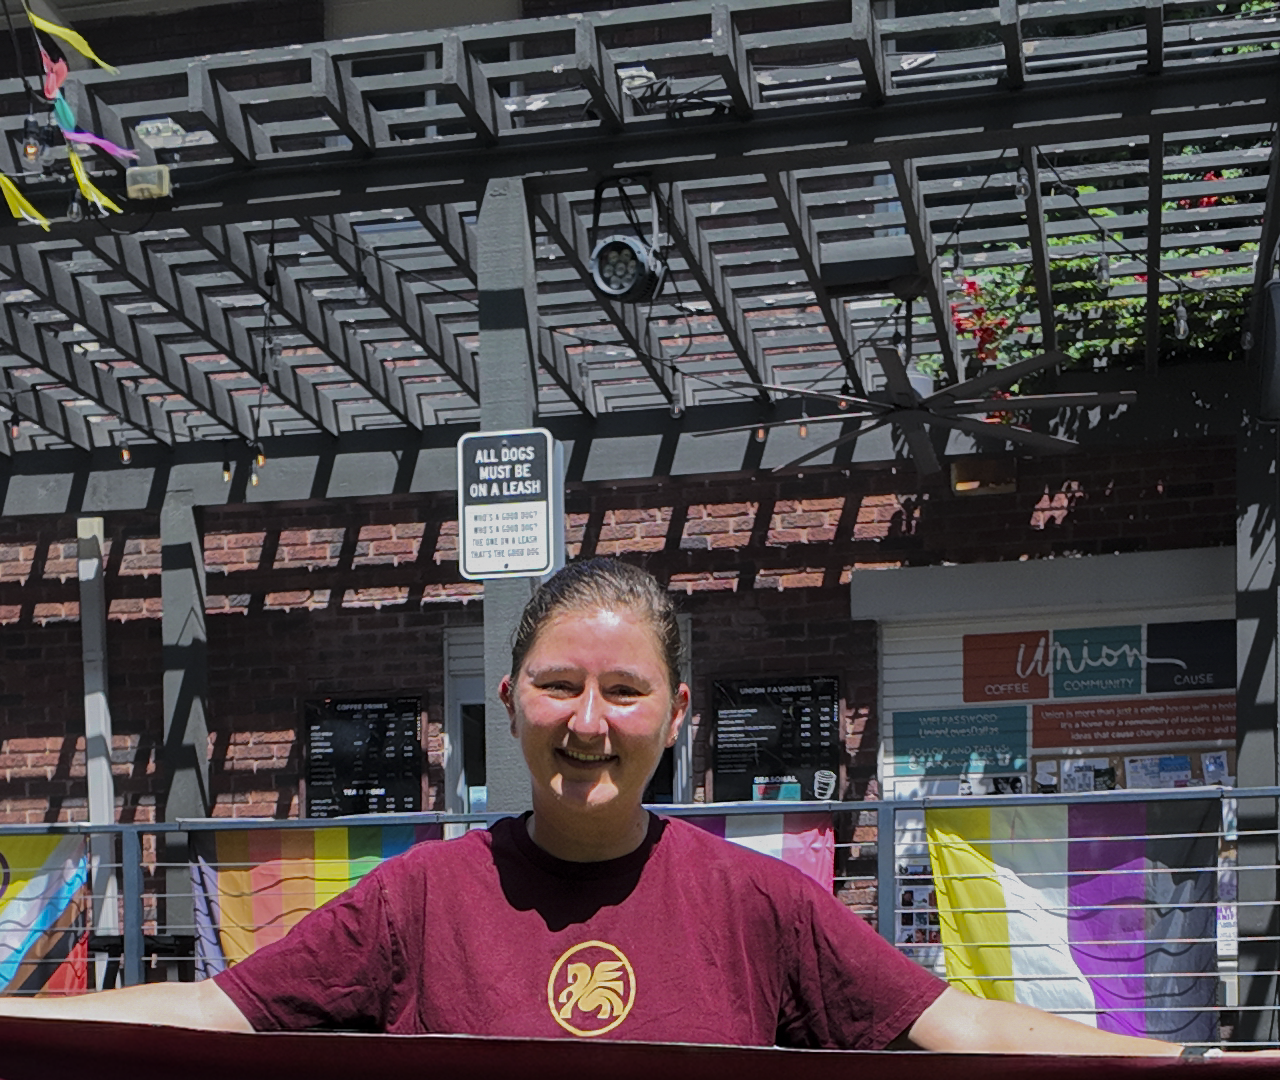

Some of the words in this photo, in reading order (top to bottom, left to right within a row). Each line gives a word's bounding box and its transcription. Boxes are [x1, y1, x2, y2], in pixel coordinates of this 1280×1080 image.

[475, 449, 499, 464] ALL
[501, 446, 535, 462] DOGS
[479, 465, 512, 480] MUST
[514, 463, 532, 478] BE
[469, 483, 488, 498] ON
[490, 482, 500, 497] A
[502, 480, 541, 496] LEASH
[474, 513, 493, 521] WHO'S
[496, 513, 500, 521] A
[502, 512, 518, 520] GOOD
[521, 511, 538, 519] DOG?
[473, 526, 493, 535] WHO'S
[496, 525, 500, 533] A
[501, 524, 519, 533] GOOD
[521, 523, 538, 532] DOG?
[485, 538, 498, 546] ONE
[517, 535, 538, 544] LEASH
[1016, 637, 1187, 679] Union
[739, 686, 766, 695] UNION
[767, 684, 812, 694] FAVORITES
[984, 683, 1030, 695] COFFEE
[1063, 678, 1134, 691] COMMUNITY
[1174, 673, 1214, 685] CAUSE
[336, 703, 363, 712] COFFEE
[363, 702, 389, 710] DRINKS
[1040, 710, 1065, 720] Union
[1066, 709, 1073, 718] is
[1074, 709, 1096, 718] more
[1096, 708, 1115, 717] than
[1116, 706, 1132, 718] just
[1140, 705, 1165, 714] coffee
[1166, 704, 1191, 713] house
[1192, 703, 1209, 711] with
[1080, 720, 1103, 728] home
[1124, 717, 1169, 726] community
[1170, 715, 1180, 724] of
[1180, 715, 1210, 724] leaders
[1070, 731, 1092, 740] ideas
[1093, 731, 1110, 739] that
[1111, 731, 1135, 739] cause
[1136, 729, 1165, 739] change
[1176, 728, 1190, 736] our
[1191, 727, 1206, 735] city
[1213, 726, 1229, 734] and
[909, 747, 949, 757] FOLLOW
[950, 745, 971, 755] AND
[973, 745, 992, 753] TAG
